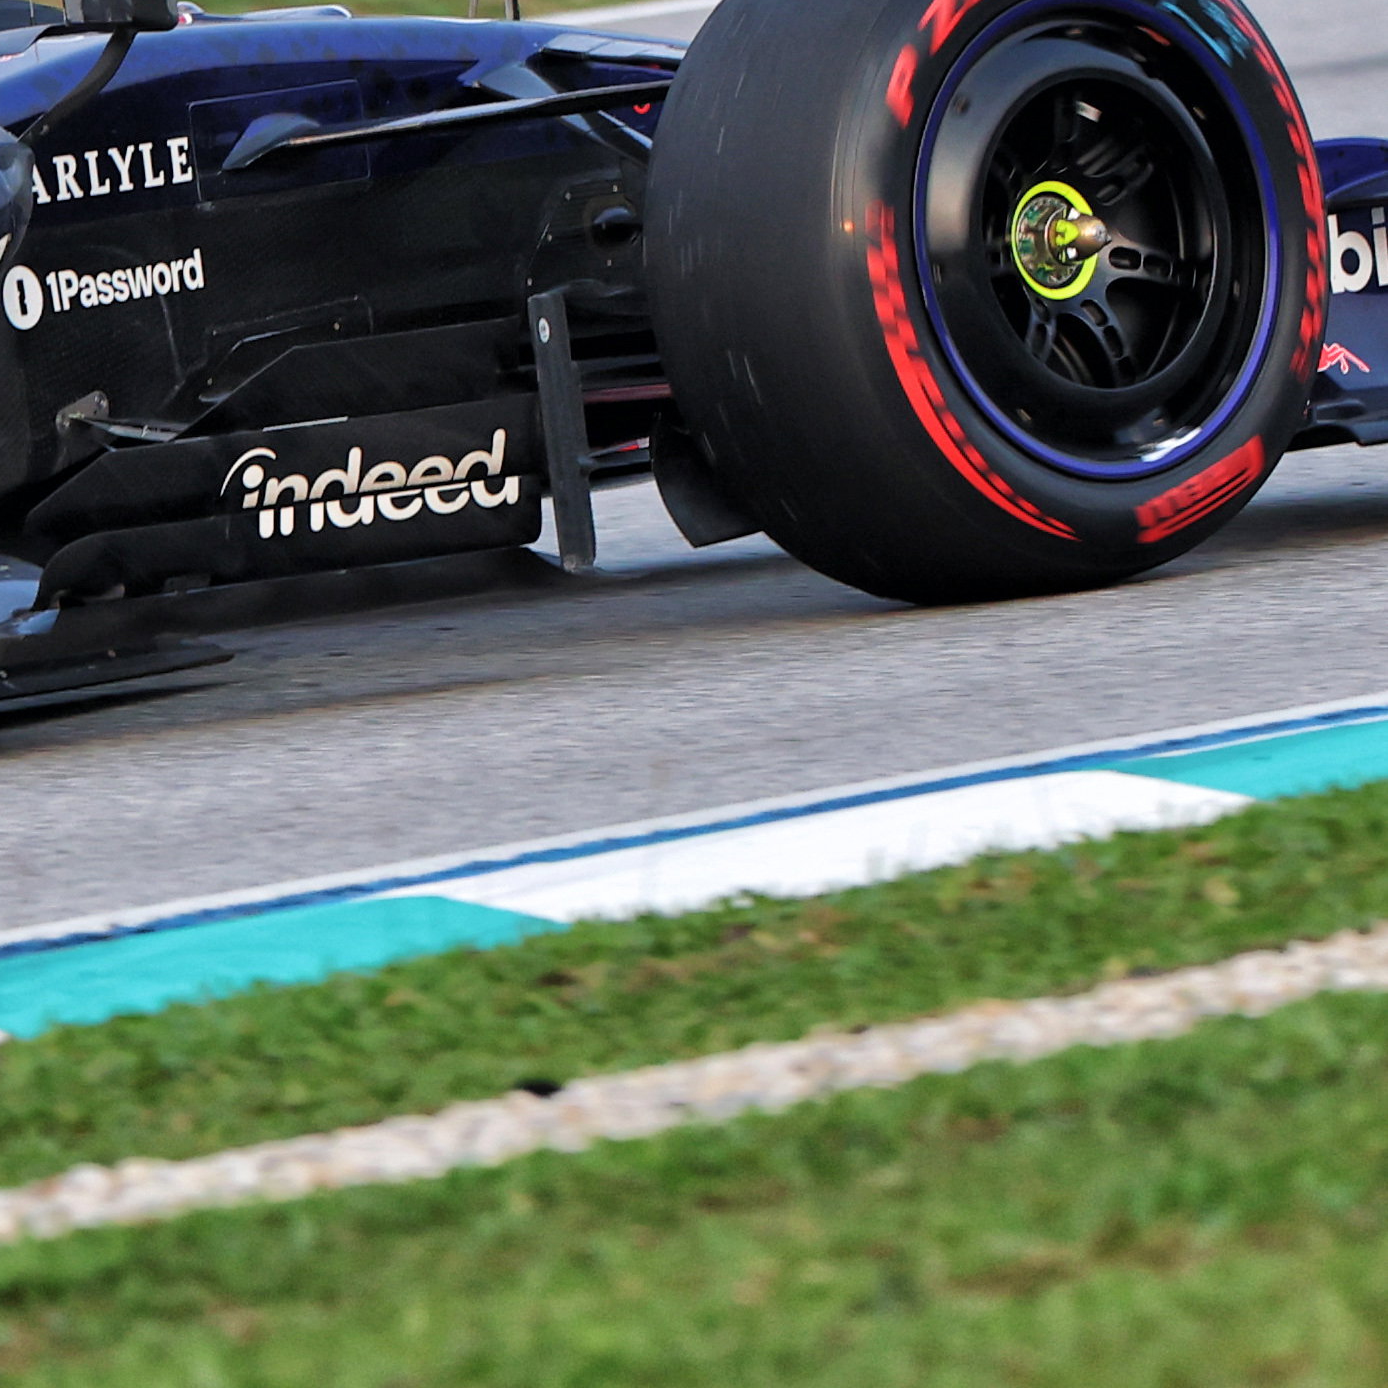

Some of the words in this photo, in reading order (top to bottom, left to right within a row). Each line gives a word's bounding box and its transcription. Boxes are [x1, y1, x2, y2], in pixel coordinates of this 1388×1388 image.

[29, 136, 193, 205] ARLYLE
[46, 248, 205, 312] 1Password
[222, 428, 520, 539] indeed
